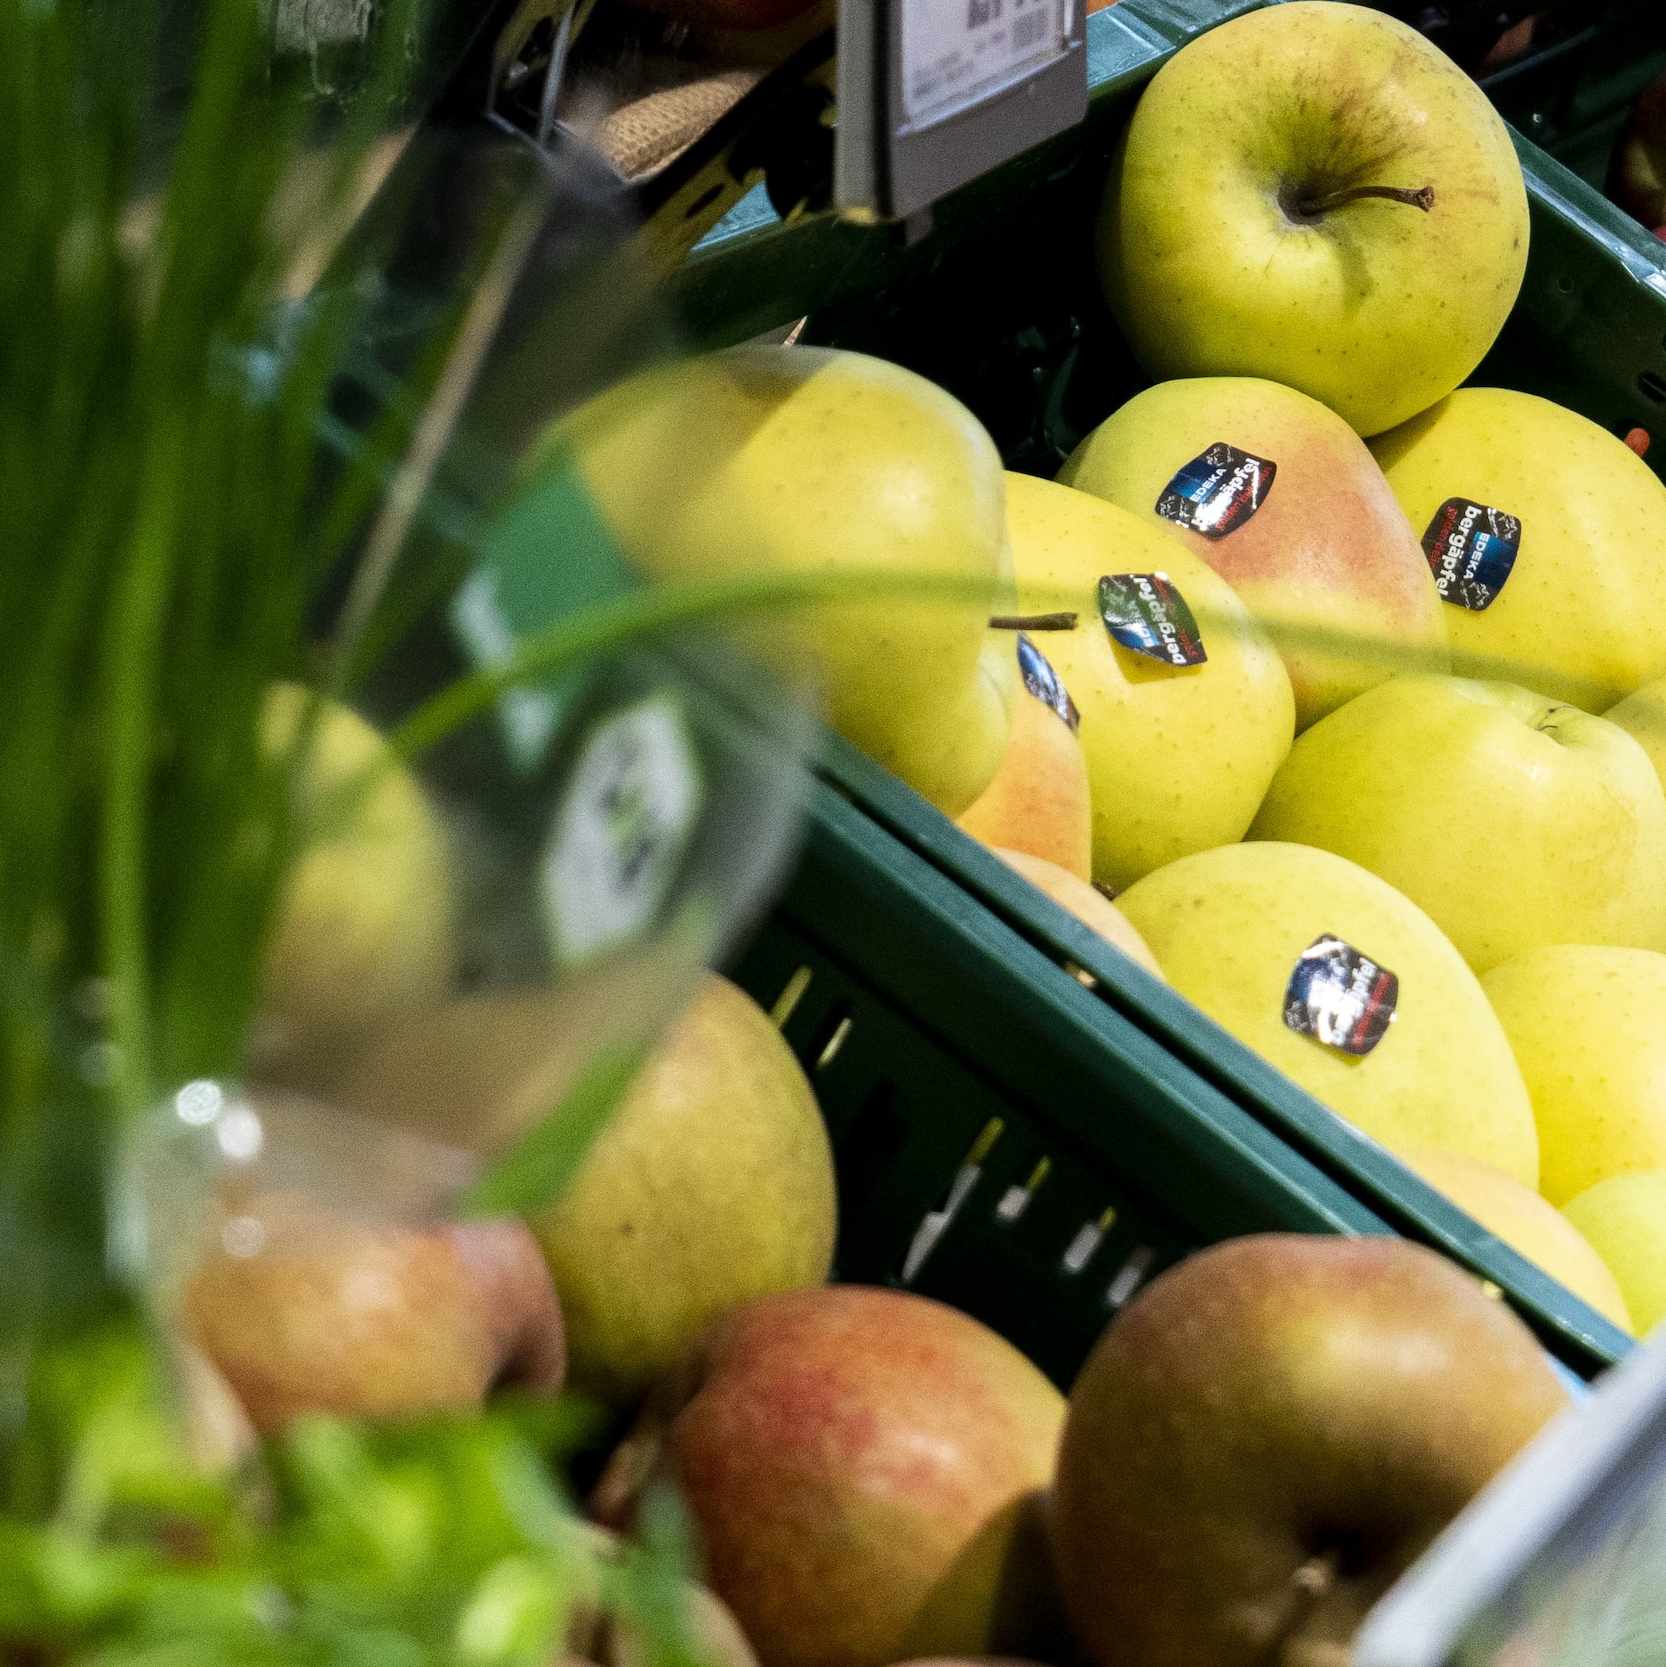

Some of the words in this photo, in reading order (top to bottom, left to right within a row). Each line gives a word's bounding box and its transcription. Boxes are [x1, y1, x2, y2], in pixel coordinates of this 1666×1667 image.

[1189, 468, 1227, 503] EDEKA
[1436, 505, 1482, 596] bergäpfel
[1463, 532, 1490, 579] EDEKA
[1133, 577, 1187, 664] bergäpfel
